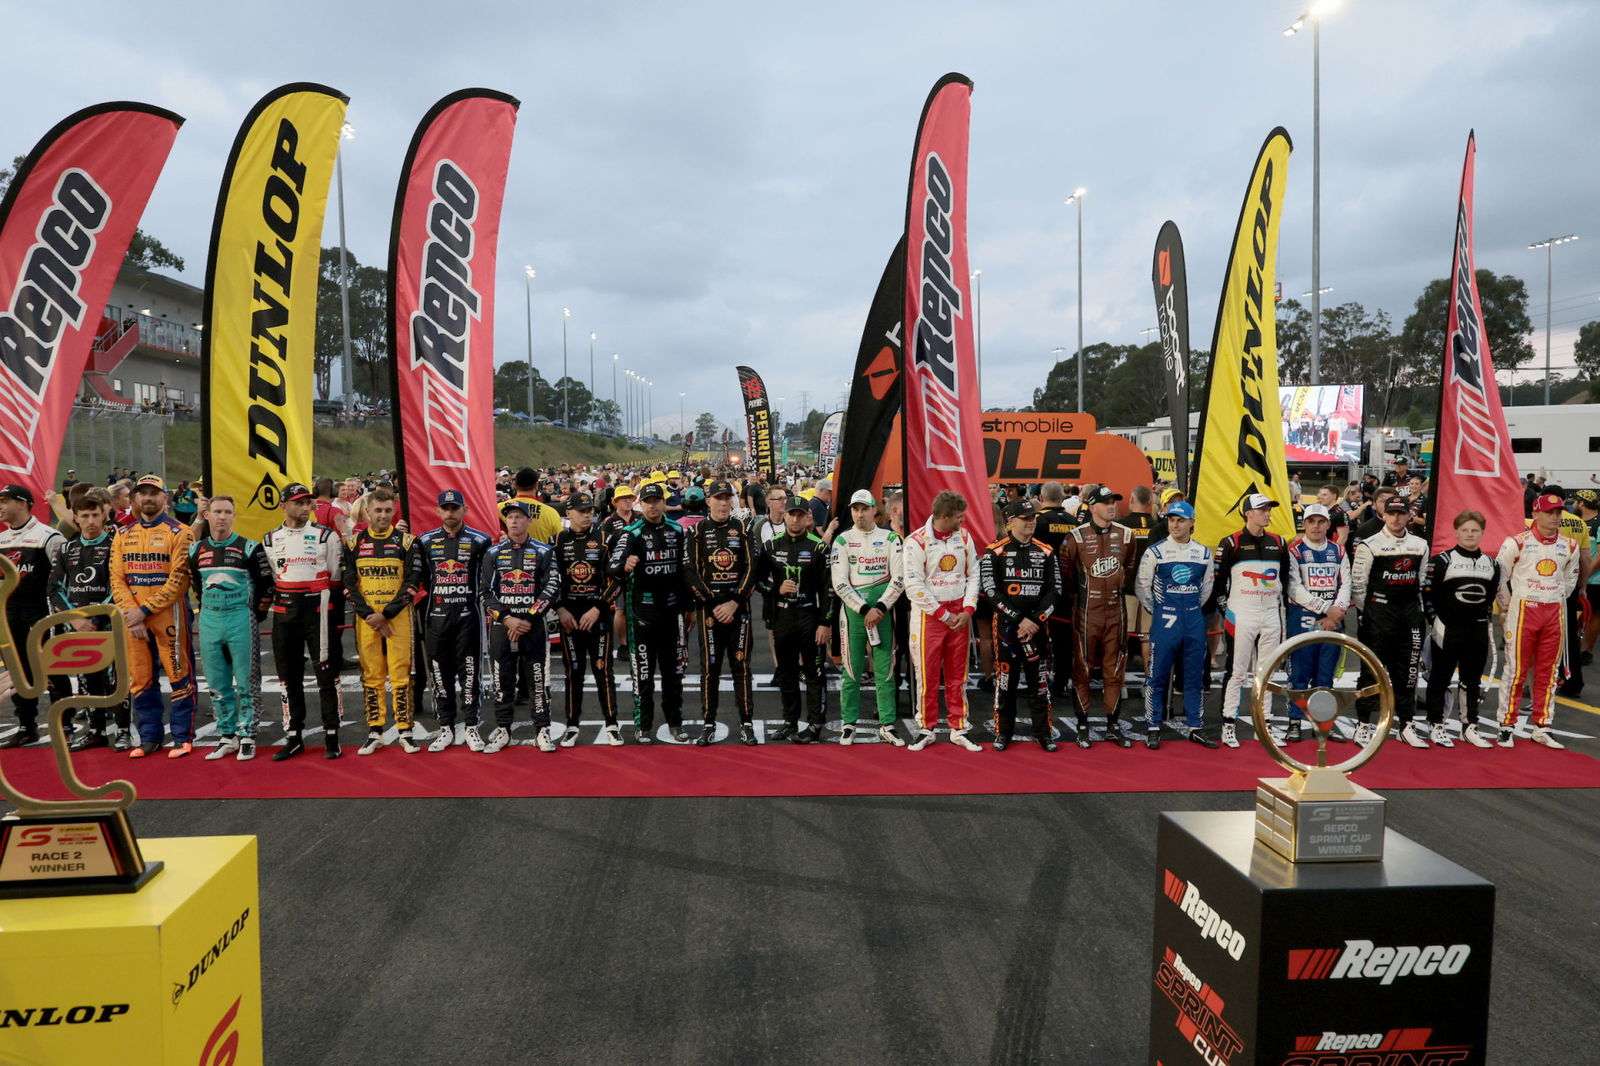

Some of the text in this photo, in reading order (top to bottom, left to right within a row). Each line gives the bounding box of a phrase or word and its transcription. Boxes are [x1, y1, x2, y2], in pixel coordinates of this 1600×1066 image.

[0, 167, 113, 405] Repco
[410, 158, 482, 397] Repco
[914, 151, 963, 400] Repco
[247, 117, 307, 476] DUNLOP
[1237, 158, 1273, 488] DUNLOP
[1158, 302, 1174, 371] mobile
[1164, 284, 1185, 395] boost
[749, 414, 758, 457] RACING
[981, 418, 1074, 433] stmobile
[756, 409, 772, 473] PENRITE
[123, 552, 170, 562] SHERRIN
[127, 561, 163, 571] Rentals
[708, 554, 738, 562] PENRITE
[858, 556, 888, 564] Castrol
[566, 567, 597, 576] PENRITE
[1005, 567, 1033, 578] Mobil
[1309, 577, 1335, 587] MOLY
[433, 586, 472, 595] AMPOL
[1161, 614, 1178, 628] 7
[1301, 616, 1316, 628] 3
[1411, 627, 1421, 649] HIRE
[638, 644, 649, 680] OPTUS
[1410, 650, 1419, 665] WE
[1309, 833, 1372, 844] SPRINT CUP
[1323, 823, 1358, 833] REPCO
[31, 851, 82, 861] RACE 2
[1317, 845, 1362, 854] WINNER
[29, 862, 86, 873] WINNER
[1180, 880, 1246, 961] Repco
[187, 907, 250, 992] DUNLOP
[1173, 952, 1202, 992] Repco
[1329, 939, 1472, 985] Repco
[0, 1003, 130, 1028] NLOP
[1156, 962, 1244, 1060] SPRINT
[1315, 1031, 1384, 1054] Repco
